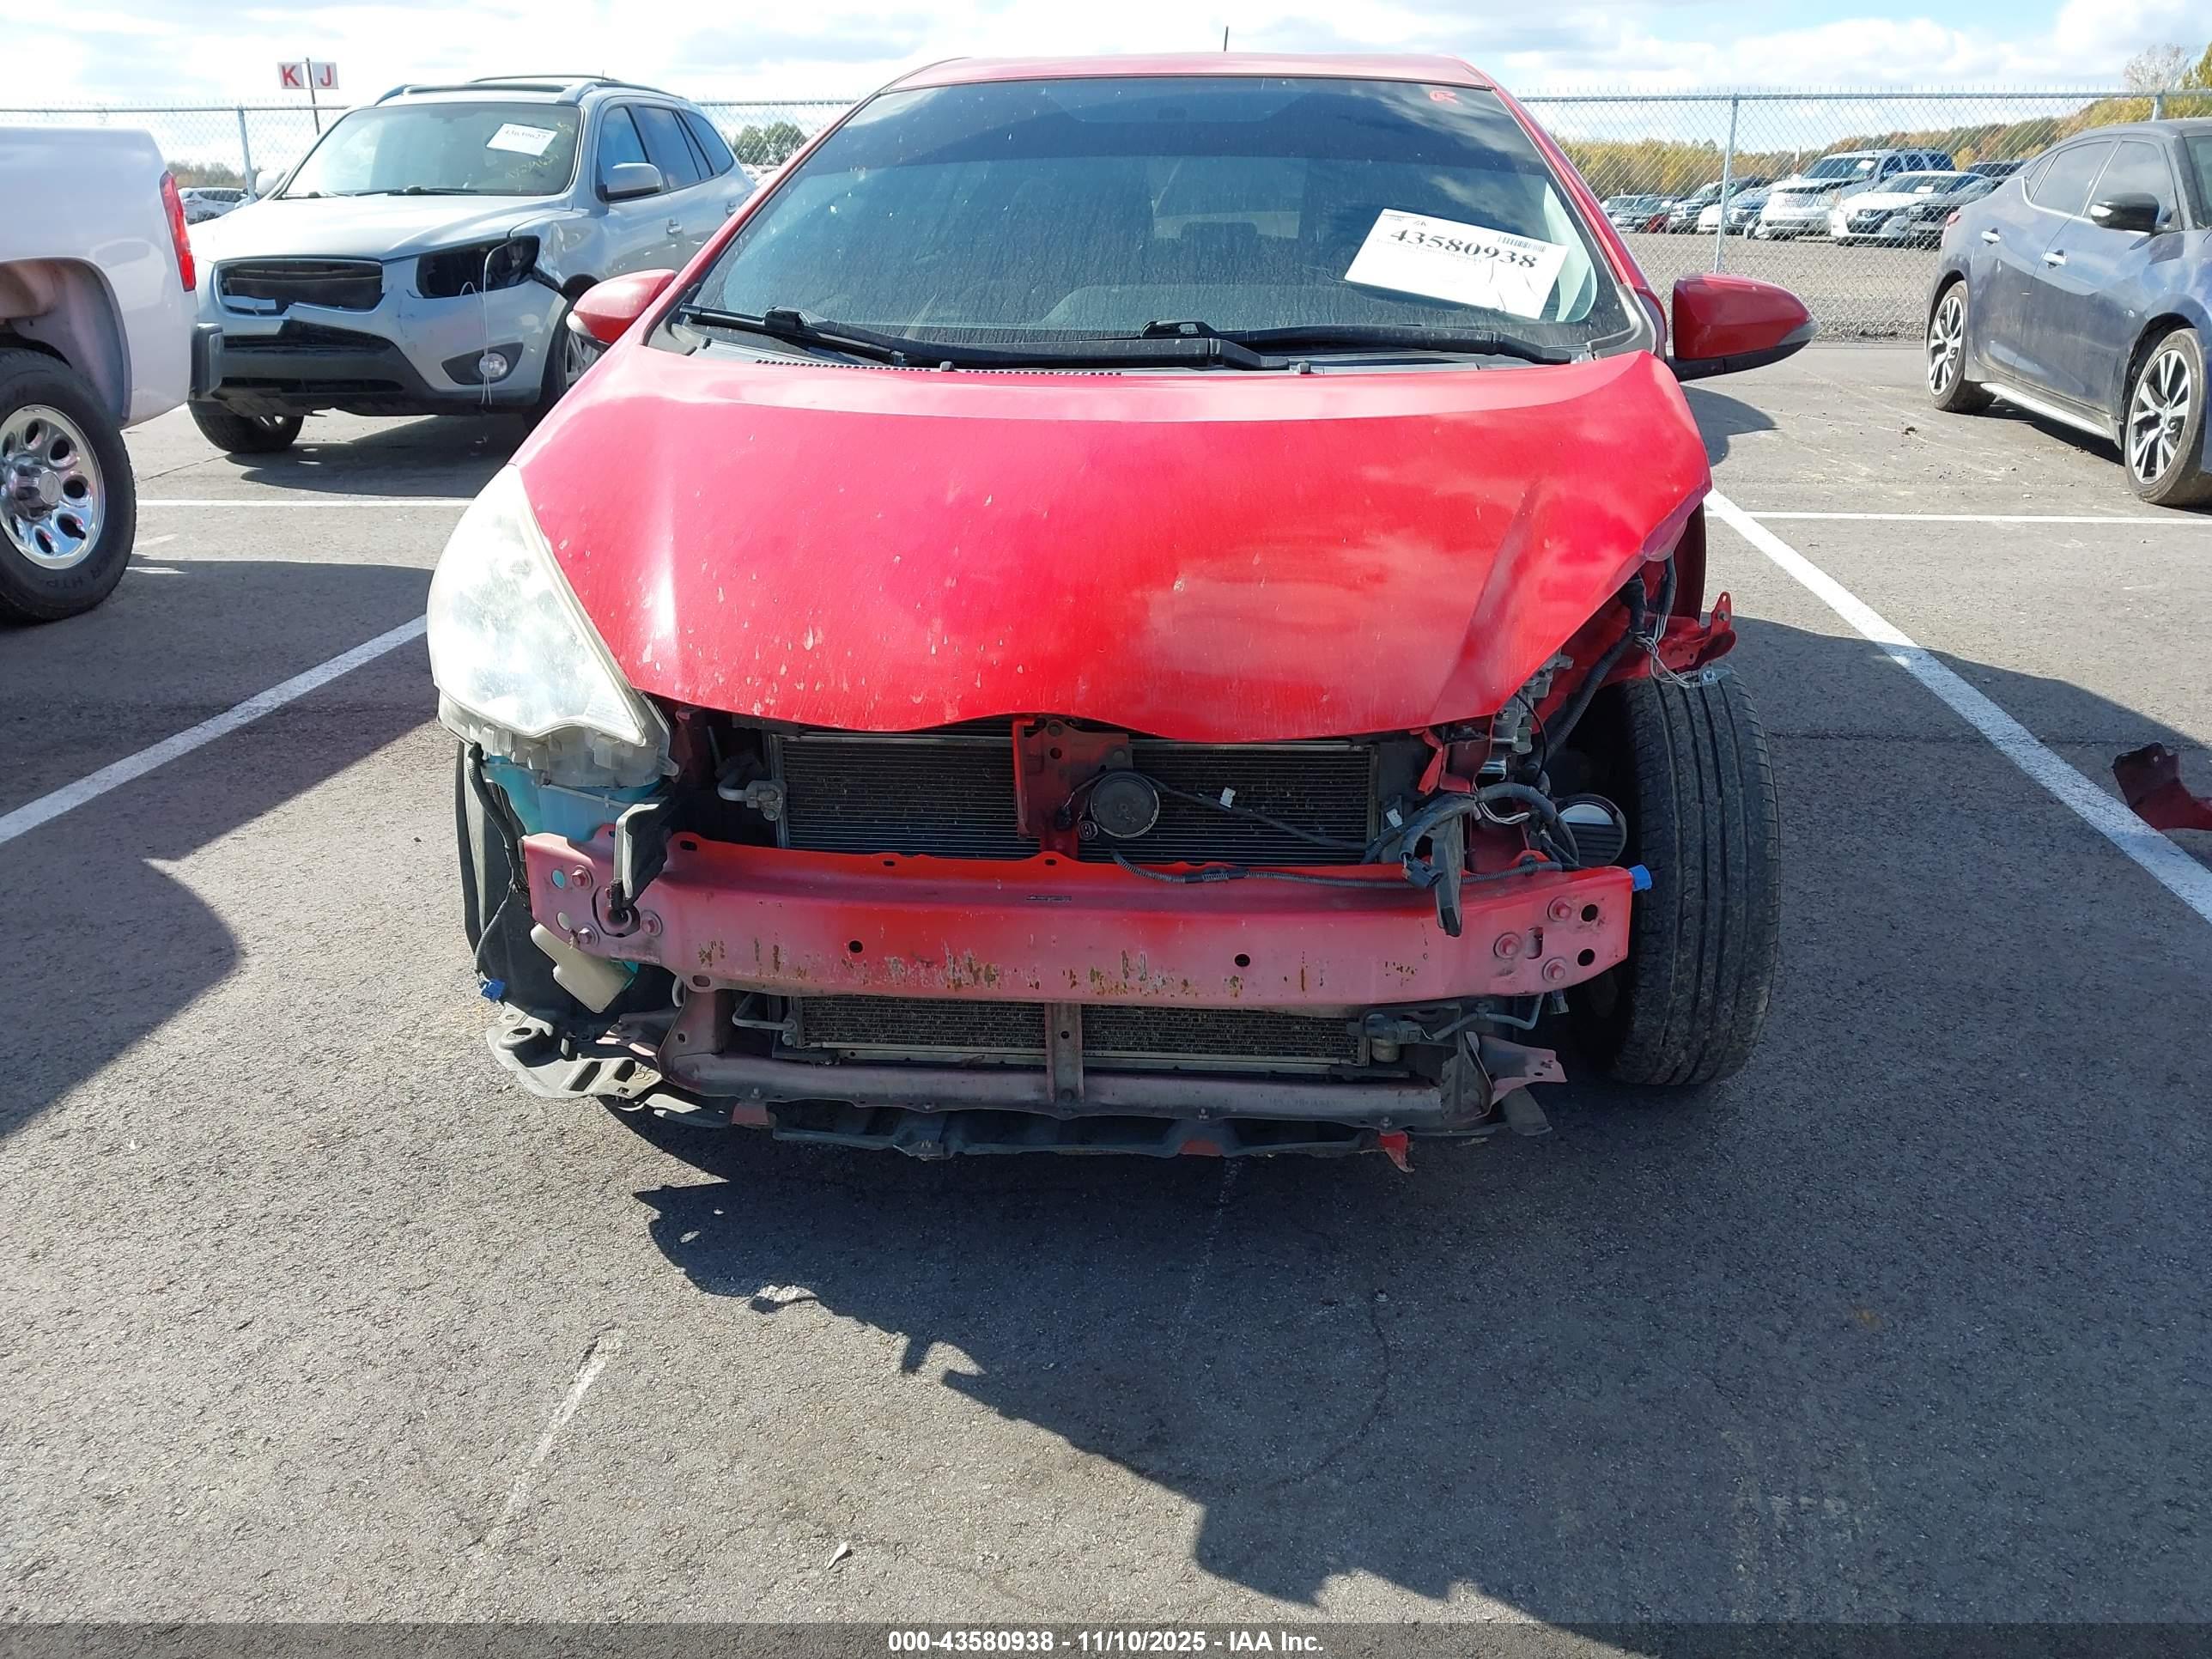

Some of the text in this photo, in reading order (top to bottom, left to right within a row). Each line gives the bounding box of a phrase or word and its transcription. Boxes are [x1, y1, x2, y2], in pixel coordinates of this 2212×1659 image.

[281, 64, 332, 87] K J
[1389, 228, 1538, 268] 43580938
